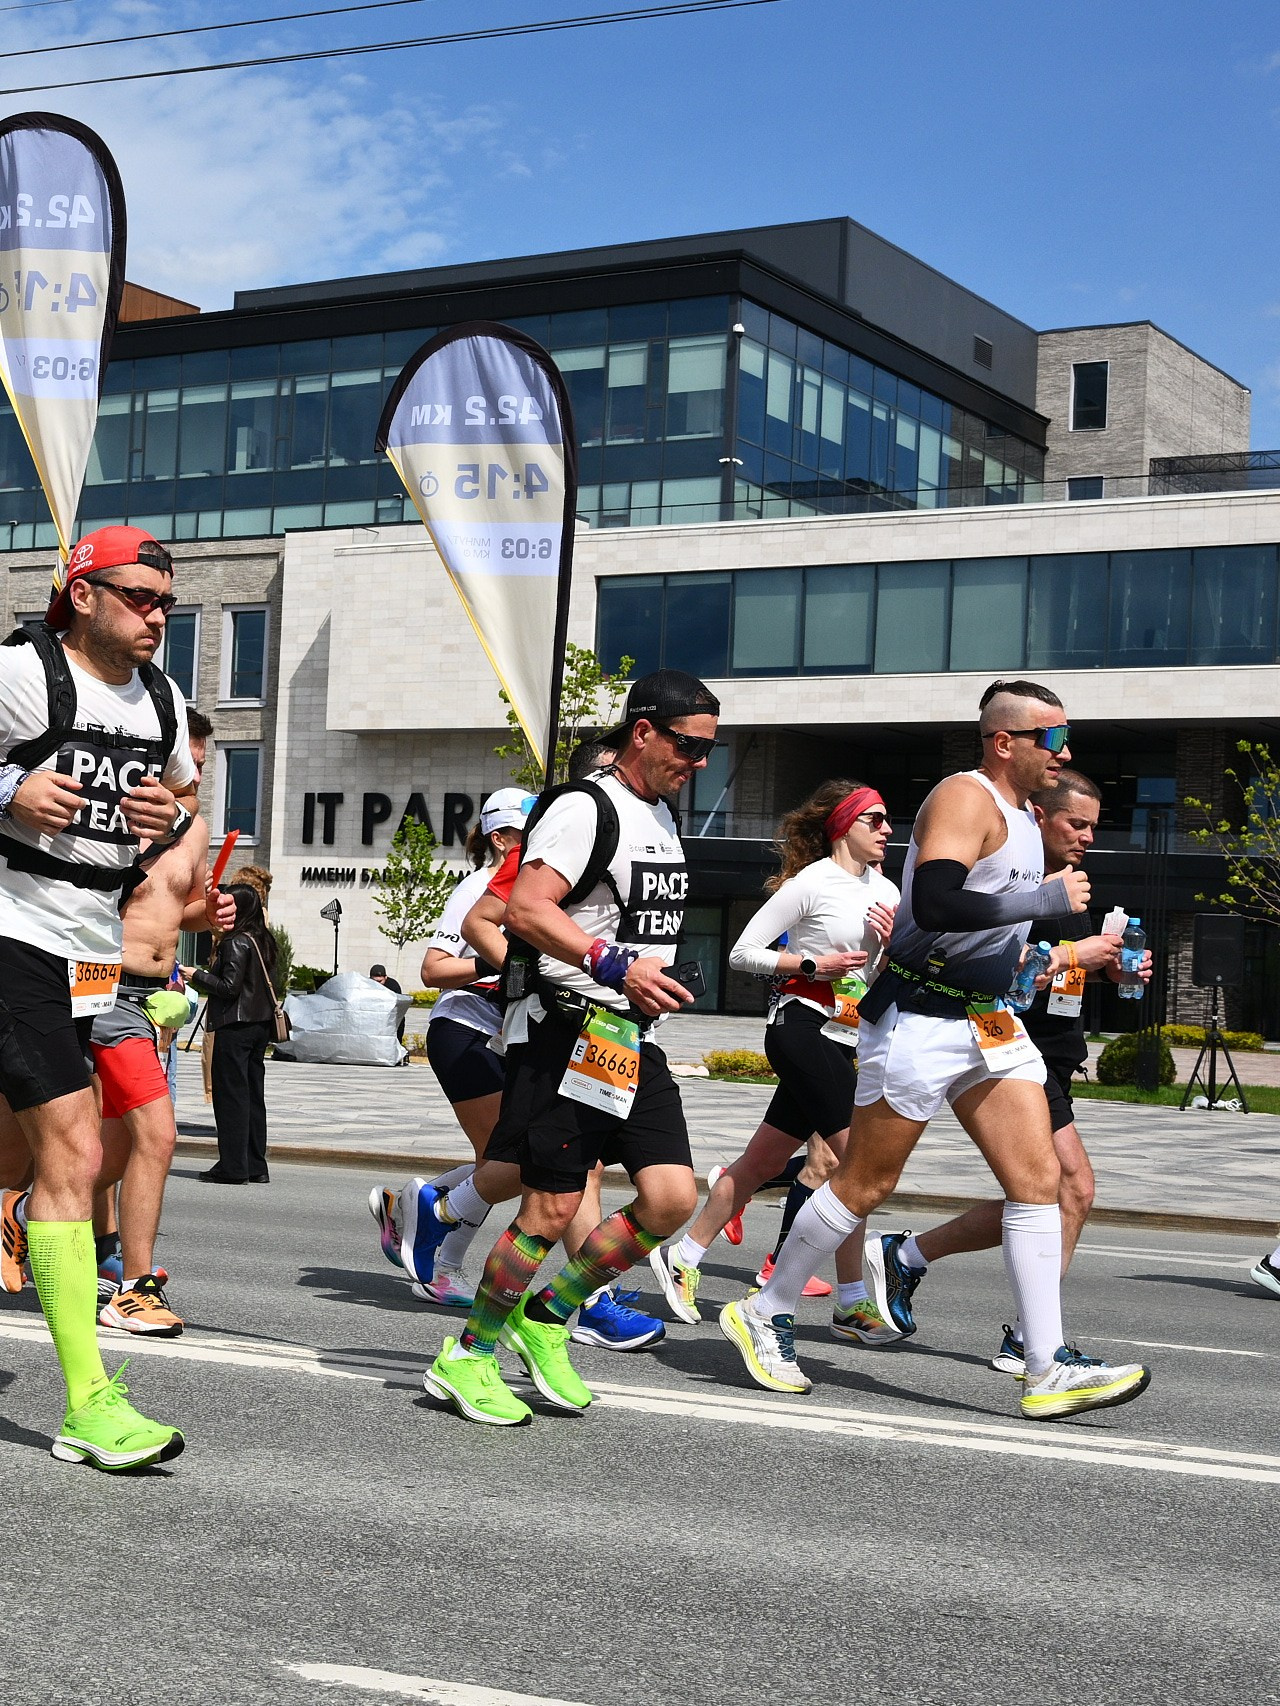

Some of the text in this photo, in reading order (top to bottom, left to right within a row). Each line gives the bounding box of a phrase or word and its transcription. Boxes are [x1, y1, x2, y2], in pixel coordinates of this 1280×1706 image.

[72, 797, 132, 835] TEA
[302, 792, 493, 846] IT PAR
[301, 866, 357, 883] ИМЕНИ
[642, 871, 689, 901] PACE
[76, 961, 117, 982] 36664
[983, 1020, 1003, 1037] 526
[575, 1044, 637, 1079] E 36663
